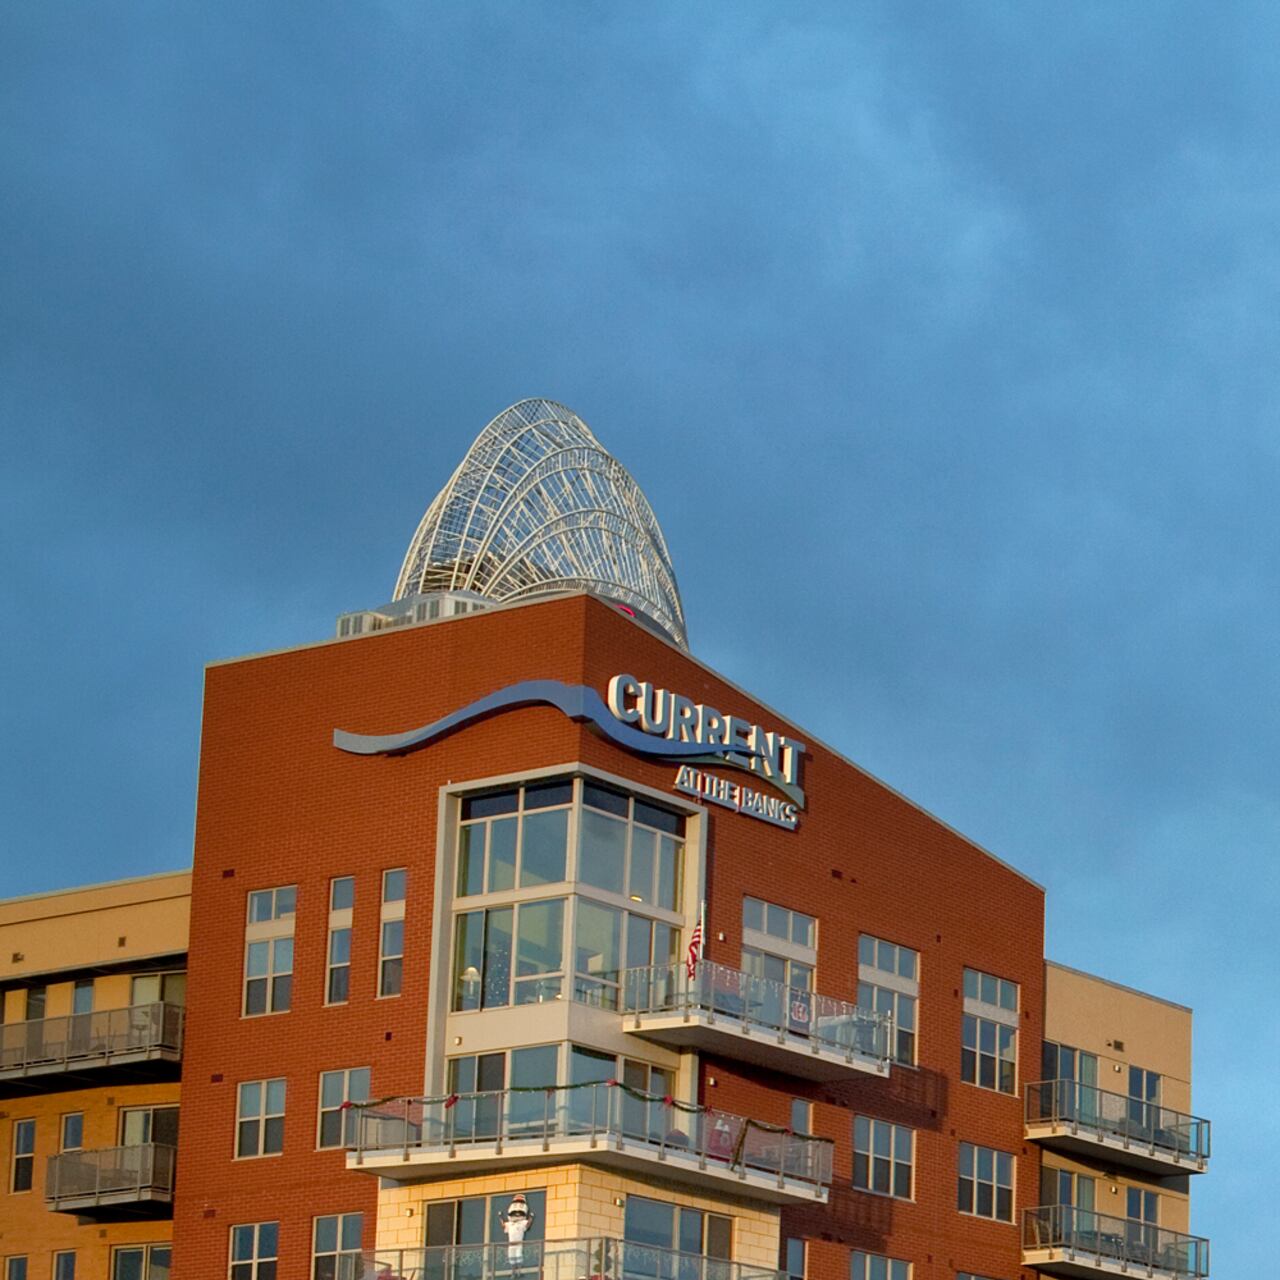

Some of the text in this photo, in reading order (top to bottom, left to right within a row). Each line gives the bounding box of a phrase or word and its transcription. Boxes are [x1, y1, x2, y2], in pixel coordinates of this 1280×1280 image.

[607, 674, 805, 785] CURRENT
[674, 764, 798, 824] AT THE BANKS
